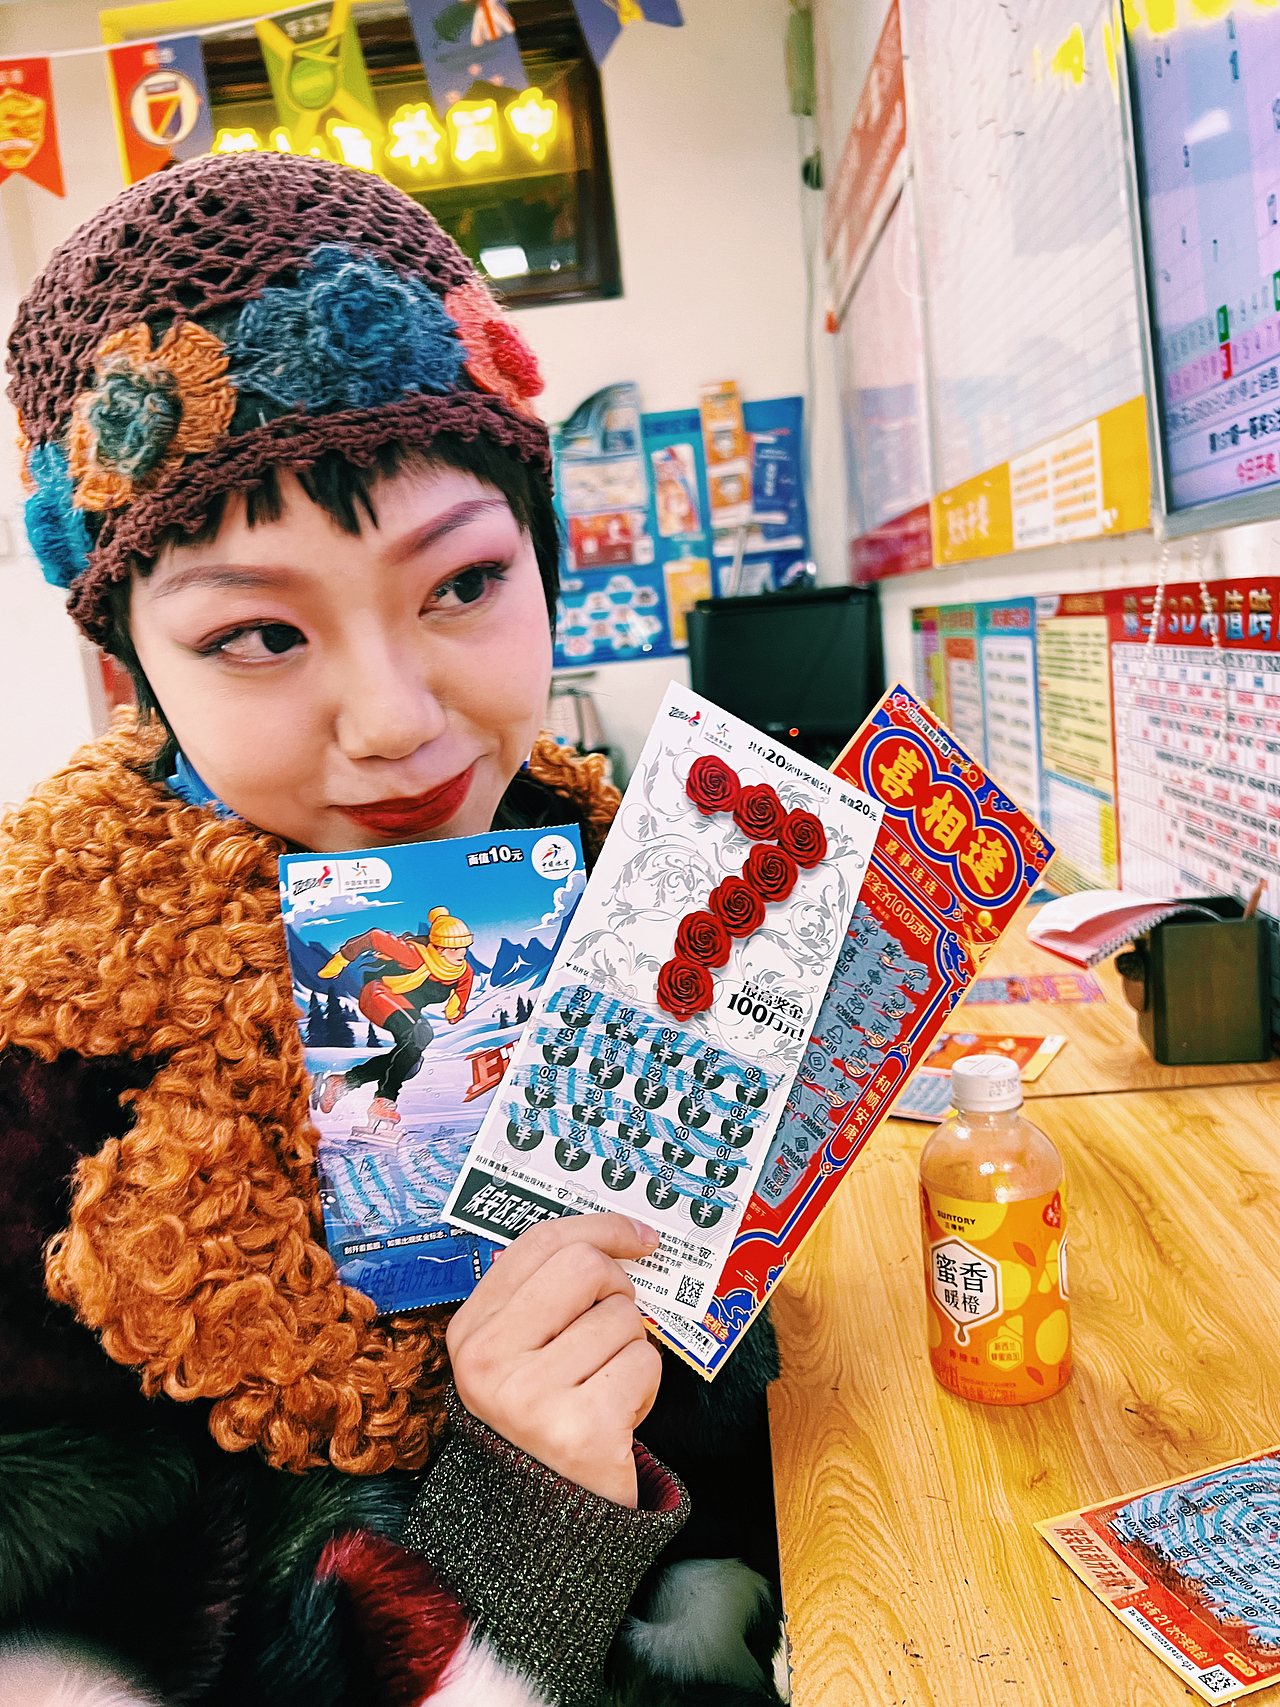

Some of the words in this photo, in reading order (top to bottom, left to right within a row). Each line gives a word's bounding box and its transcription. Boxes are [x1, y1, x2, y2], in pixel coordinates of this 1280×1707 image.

[839, 793, 878, 822] 面值20元
[878, 746, 1009, 895] 喜相逢
[467, 845, 525, 868] 面值10元
[884, 838, 939, 897] 喜事连连
[741, 980, 805, 1022] 最高奖金
[574, 986, 592, 1002] 39
[618, 1008, 634, 1023] 16
[661, 1028, 678, 1043] 09
[703, 1048, 719, 1063] 34
[745, 1067, 761, 1082] 02
[539, 1065, 558, 1082] 08
[630, 1106, 646, 1121] 24
[716, 1146, 731, 1160] 01
[604, 1048, 618, 1062] 11
[646, 1066, 662, 1082] 22
[730, 1106, 747, 1120] 03
[842, 1075, 891, 1143] 和顺安康
[523, 1107, 539, 1122] 15
[568, 1126, 586, 1142] 26
[615, 1146, 630, 1162] 14
[658, 1165, 674, 1180] 28
[702, 1185, 716, 1198] 19
[936, 1210, 976, 1226] SUNTORY
[935, 1251, 989, 1294] 蜜香
[944, 1288, 982, 1316] 暖橙
